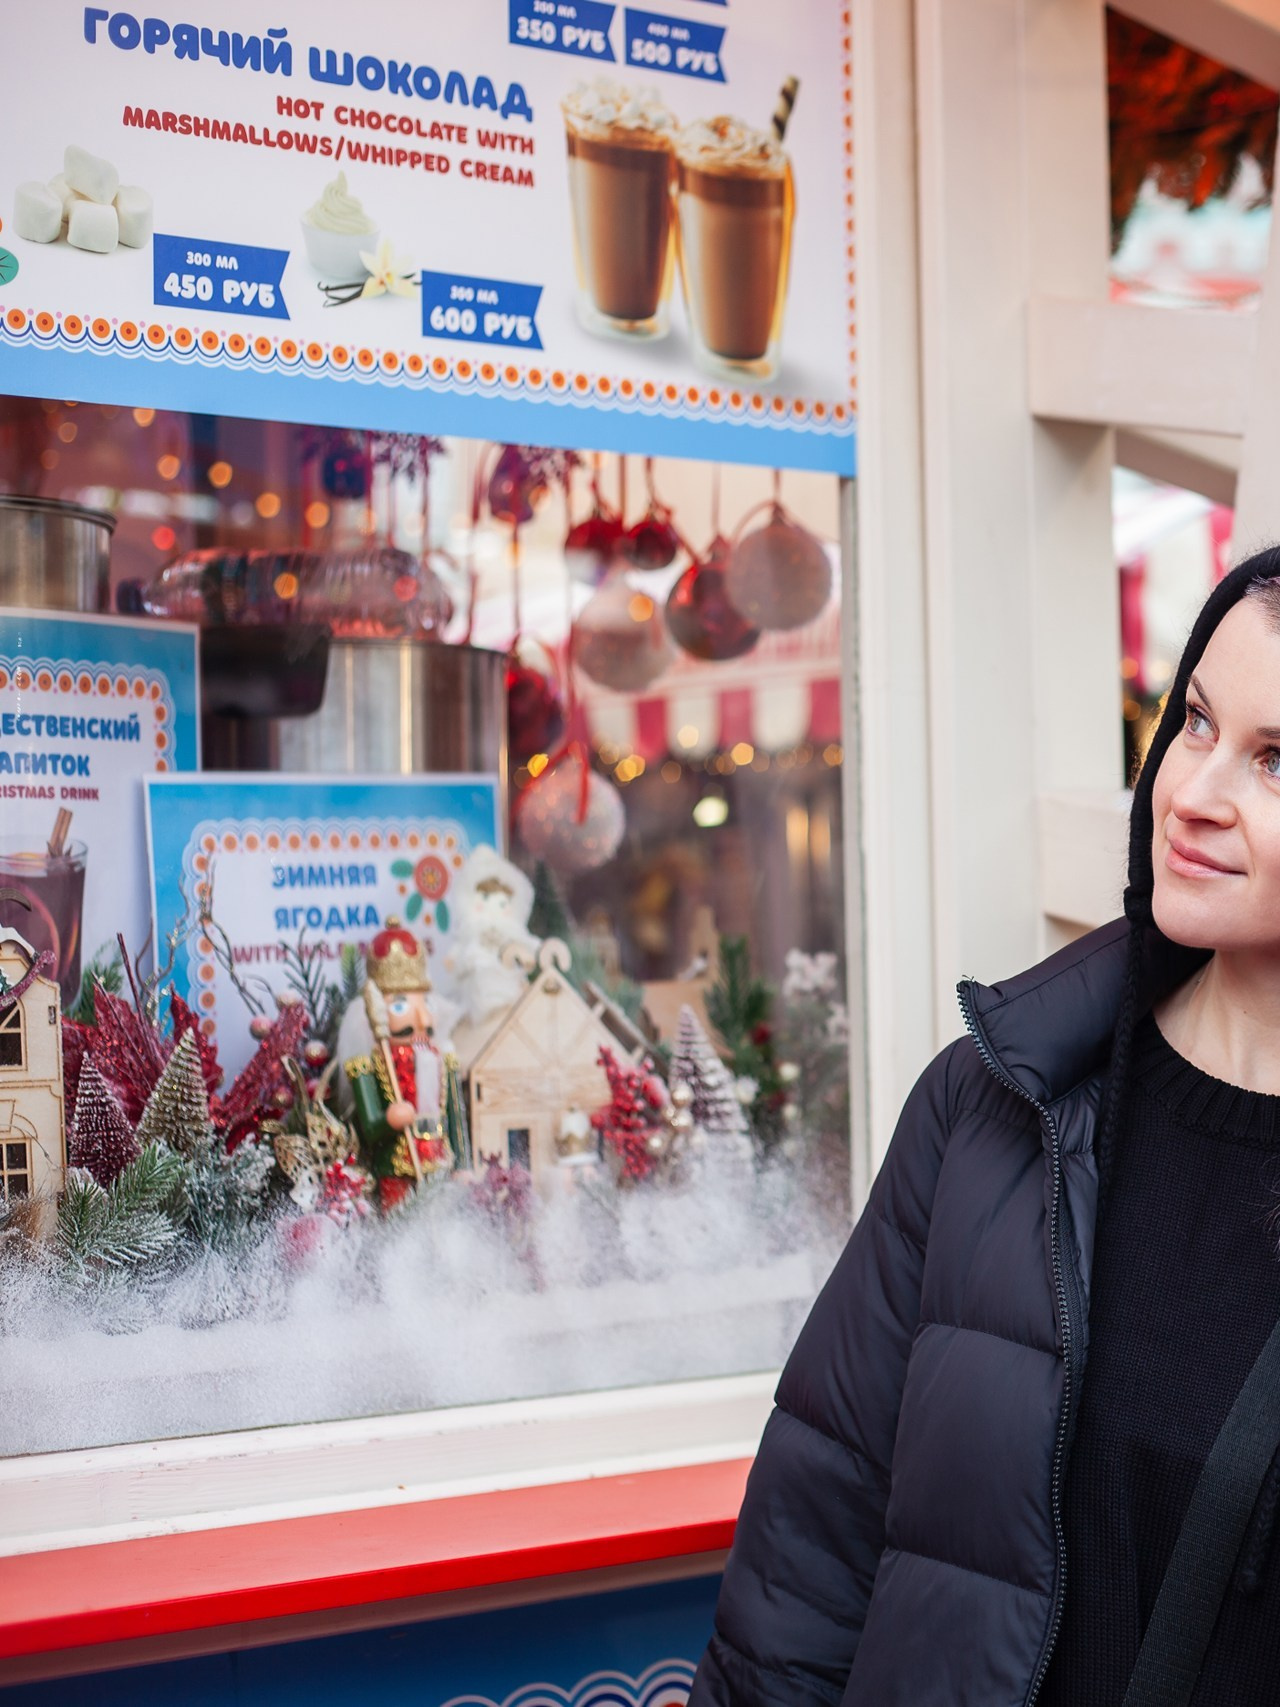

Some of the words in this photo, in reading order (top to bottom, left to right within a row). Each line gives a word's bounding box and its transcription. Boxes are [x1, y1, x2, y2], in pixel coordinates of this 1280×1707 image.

[516, 16, 557, 44] 350
[562, 25, 606, 54] РУБ
[83, 7, 293, 78] ГОРЯЧИЙ
[308, 46, 534, 123] ШОКОЛАД
[631, 38, 672, 66] 500
[676, 47, 718, 75] РУБ
[276, 95, 325, 122] HOT
[334, 106, 468, 144] CHOCOLATE
[476, 130, 535, 155] WITH
[122, 105, 450, 175] MARSHMALLOWS/WHIPPED
[459, 159, 535, 188] CREAM
[186, 251, 212, 267] 300
[163, 272, 214, 301] 450
[222, 279, 276, 309] РУБ
[449, 285, 475, 302] 300
[430, 305, 477, 335] 600
[483, 311, 533, 341] РУБ
[0, 713, 140, 742] ЕСТВЕНСКИЙ
[60, 786, 100, 801] DRINK
[272, 864, 377, 888] ЗИМНЯЯ
[274, 904, 380, 931] ЯГОДКА
